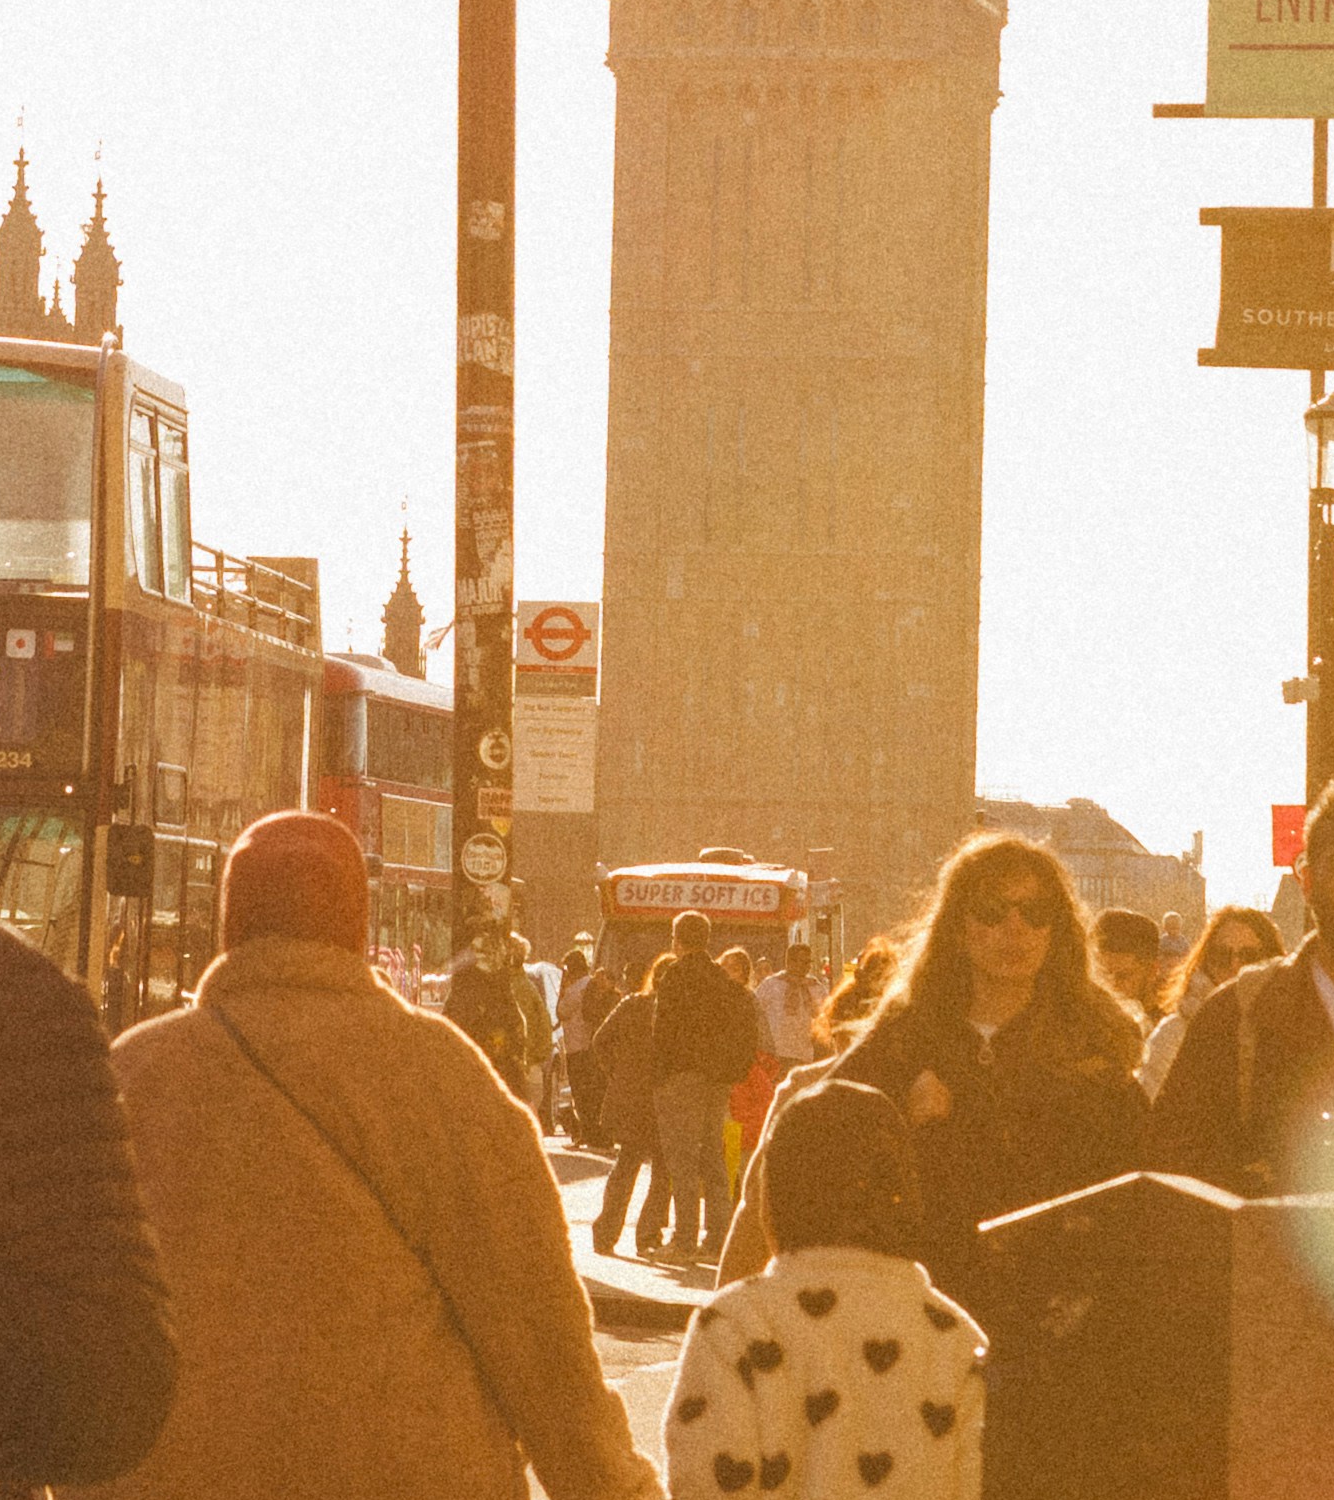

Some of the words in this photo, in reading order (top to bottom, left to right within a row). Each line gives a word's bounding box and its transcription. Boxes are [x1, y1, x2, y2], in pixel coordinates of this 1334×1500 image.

[624, 881, 684, 902] SUPER
[690, 883, 736, 905] SOFT
[743, 887, 772, 907] ICE
